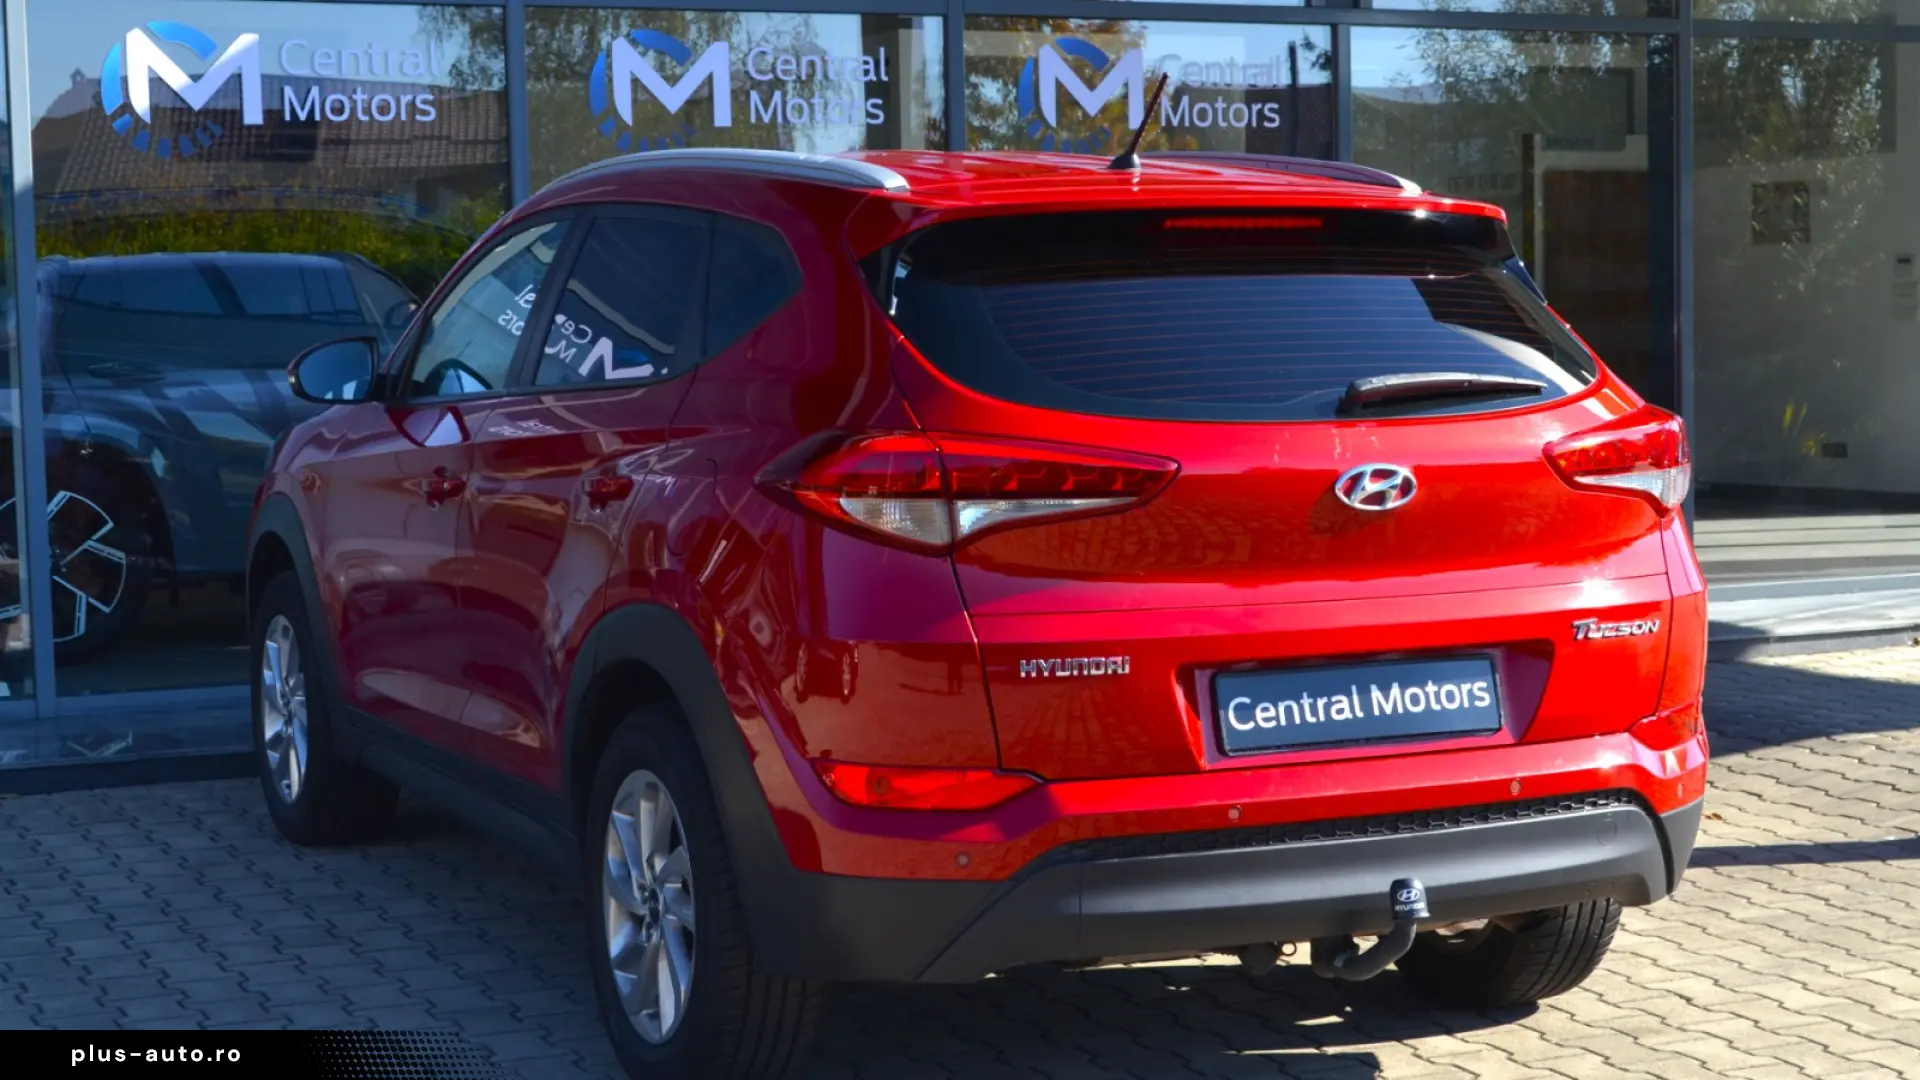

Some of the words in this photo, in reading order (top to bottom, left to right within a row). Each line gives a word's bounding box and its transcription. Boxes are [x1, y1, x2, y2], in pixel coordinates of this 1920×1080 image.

[280, 40, 439, 77] Central
[283, 85, 437, 122] Motors
[749, 89, 886, 125] Motors
[1160, 95, 1281, 128] Motors
[1020, 656, 1130, 678] HYUNDAI
[1228, 685, 1364, 731] Central
[1370, 680, 1491, 716] Motors
[1394, 902, 1425, 912] HYUND
